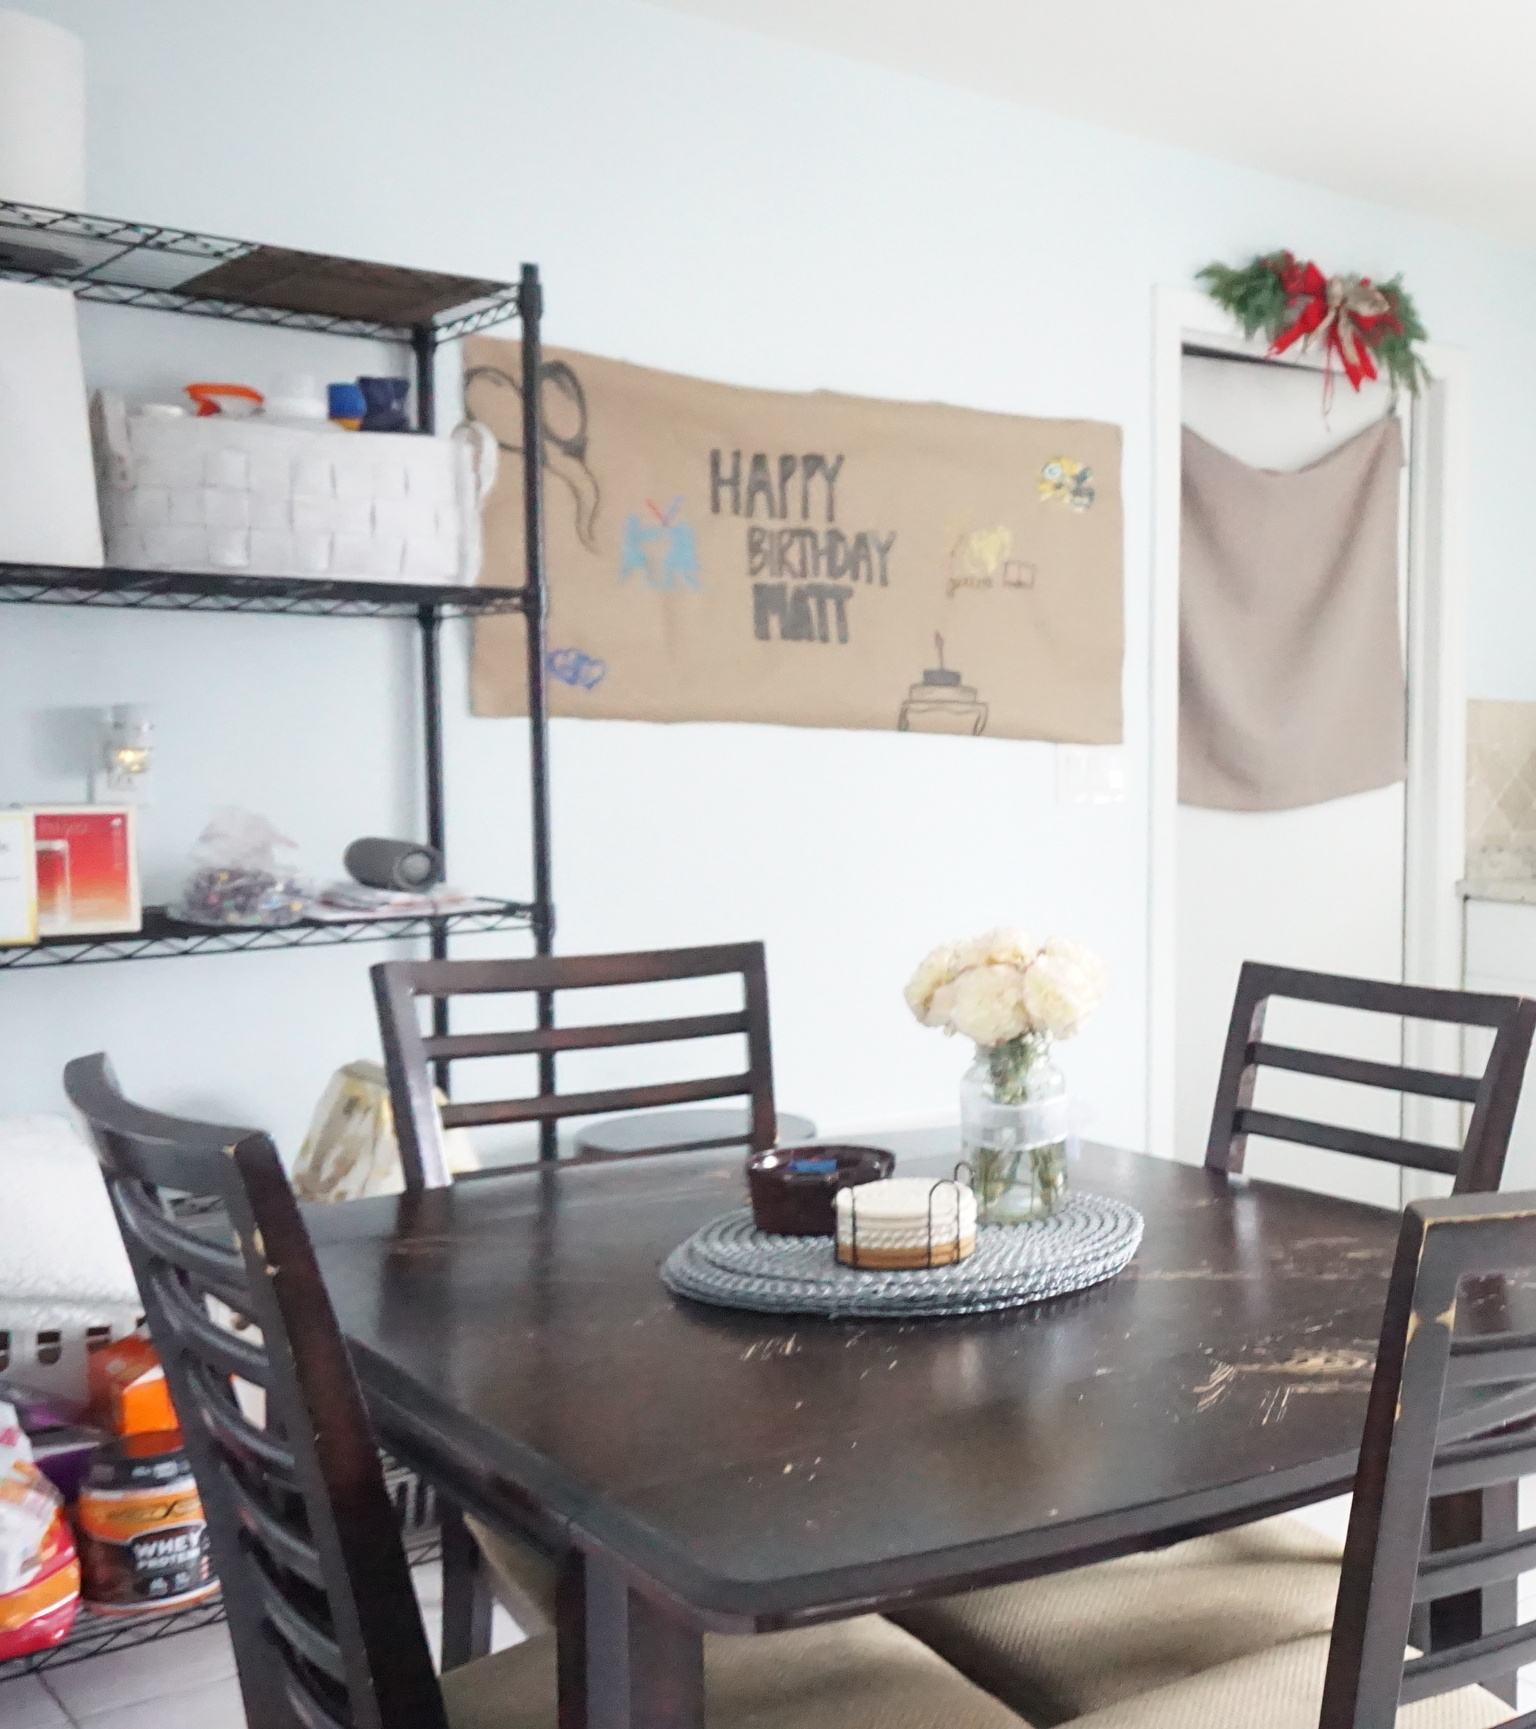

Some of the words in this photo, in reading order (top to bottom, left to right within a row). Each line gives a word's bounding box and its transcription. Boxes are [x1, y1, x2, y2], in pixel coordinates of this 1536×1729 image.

[709, 448, 845, 522] HAPPY
[746, 525, 897, 587] BIRTHDAY
[752, 582, 854, 644] MATT
[134, 1530, 202, 1560] WHEY
